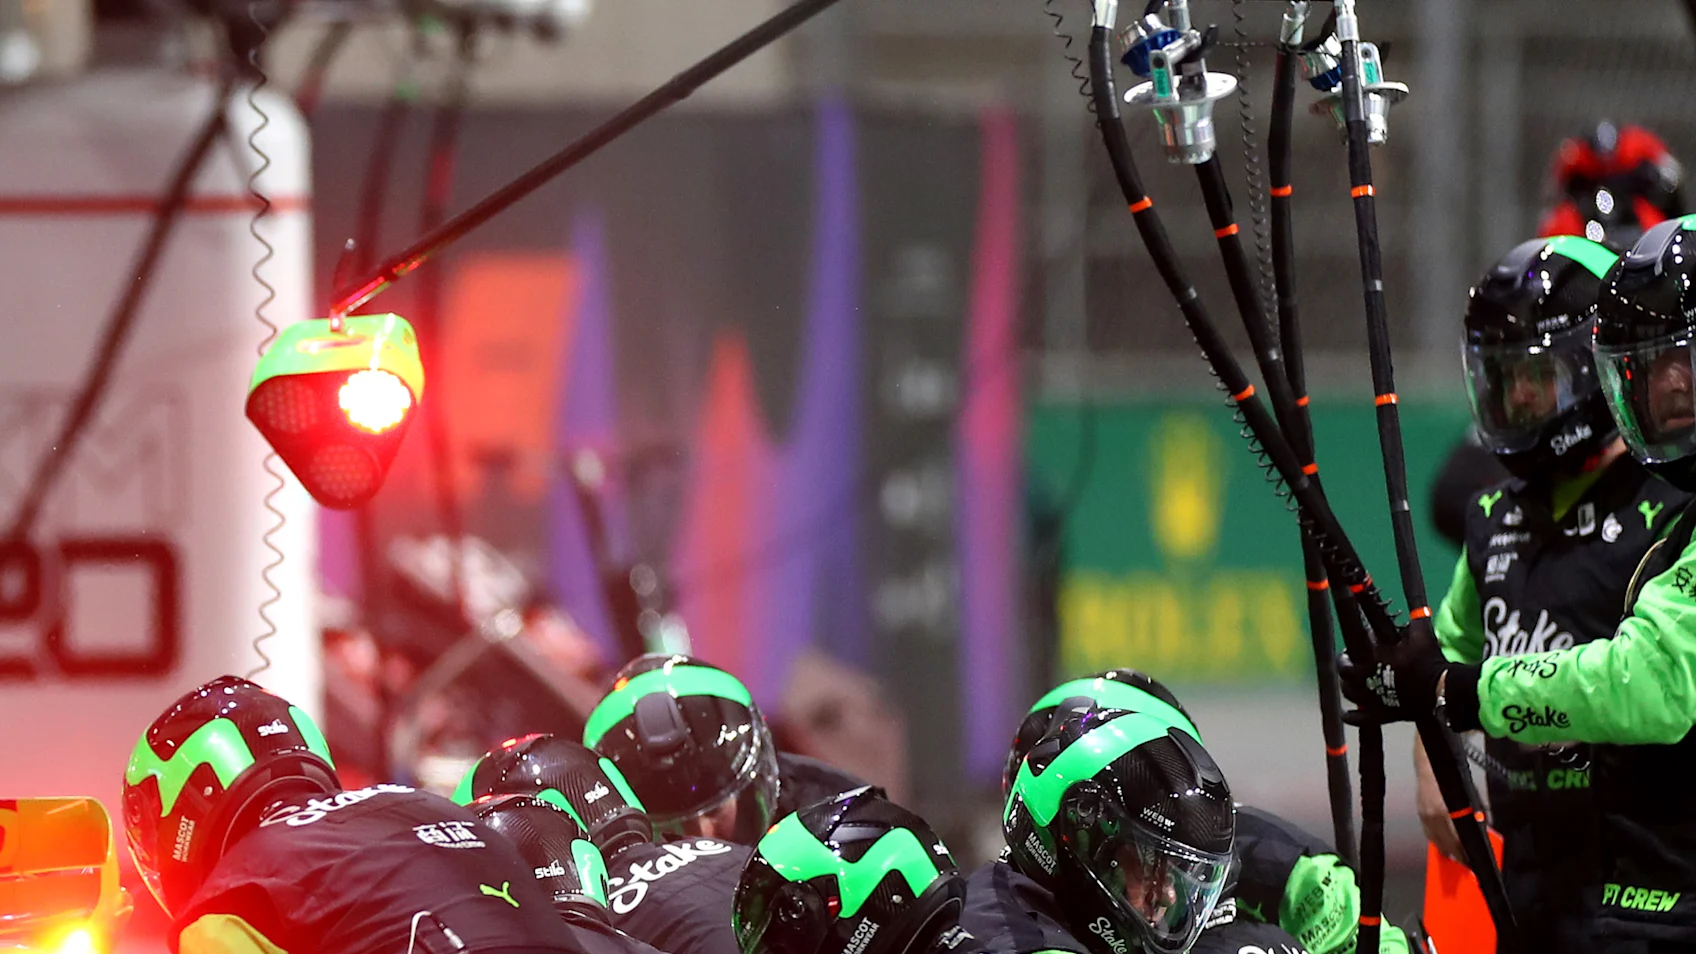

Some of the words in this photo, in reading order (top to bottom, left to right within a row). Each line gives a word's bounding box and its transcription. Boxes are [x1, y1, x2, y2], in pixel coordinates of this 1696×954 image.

[1550, 424, 1593, 456] Stake
[1483, 596, 1575, 660] Stake
[257, 718, 289, 737] Stilo
[1502, 704, 1572, 734] Stake
[584, 783, 610, 804] Stilo
[172, 815, 192, 862] MASCOT
[1027, 832, 1057, 869] MASCOT
[535, 862, 565, 879] Stilo
[1024, 839, 1054, 876] WORKWEAR
[608, 839, 732, 914] Stake
[1620, 886, 1681, 912] CREW
